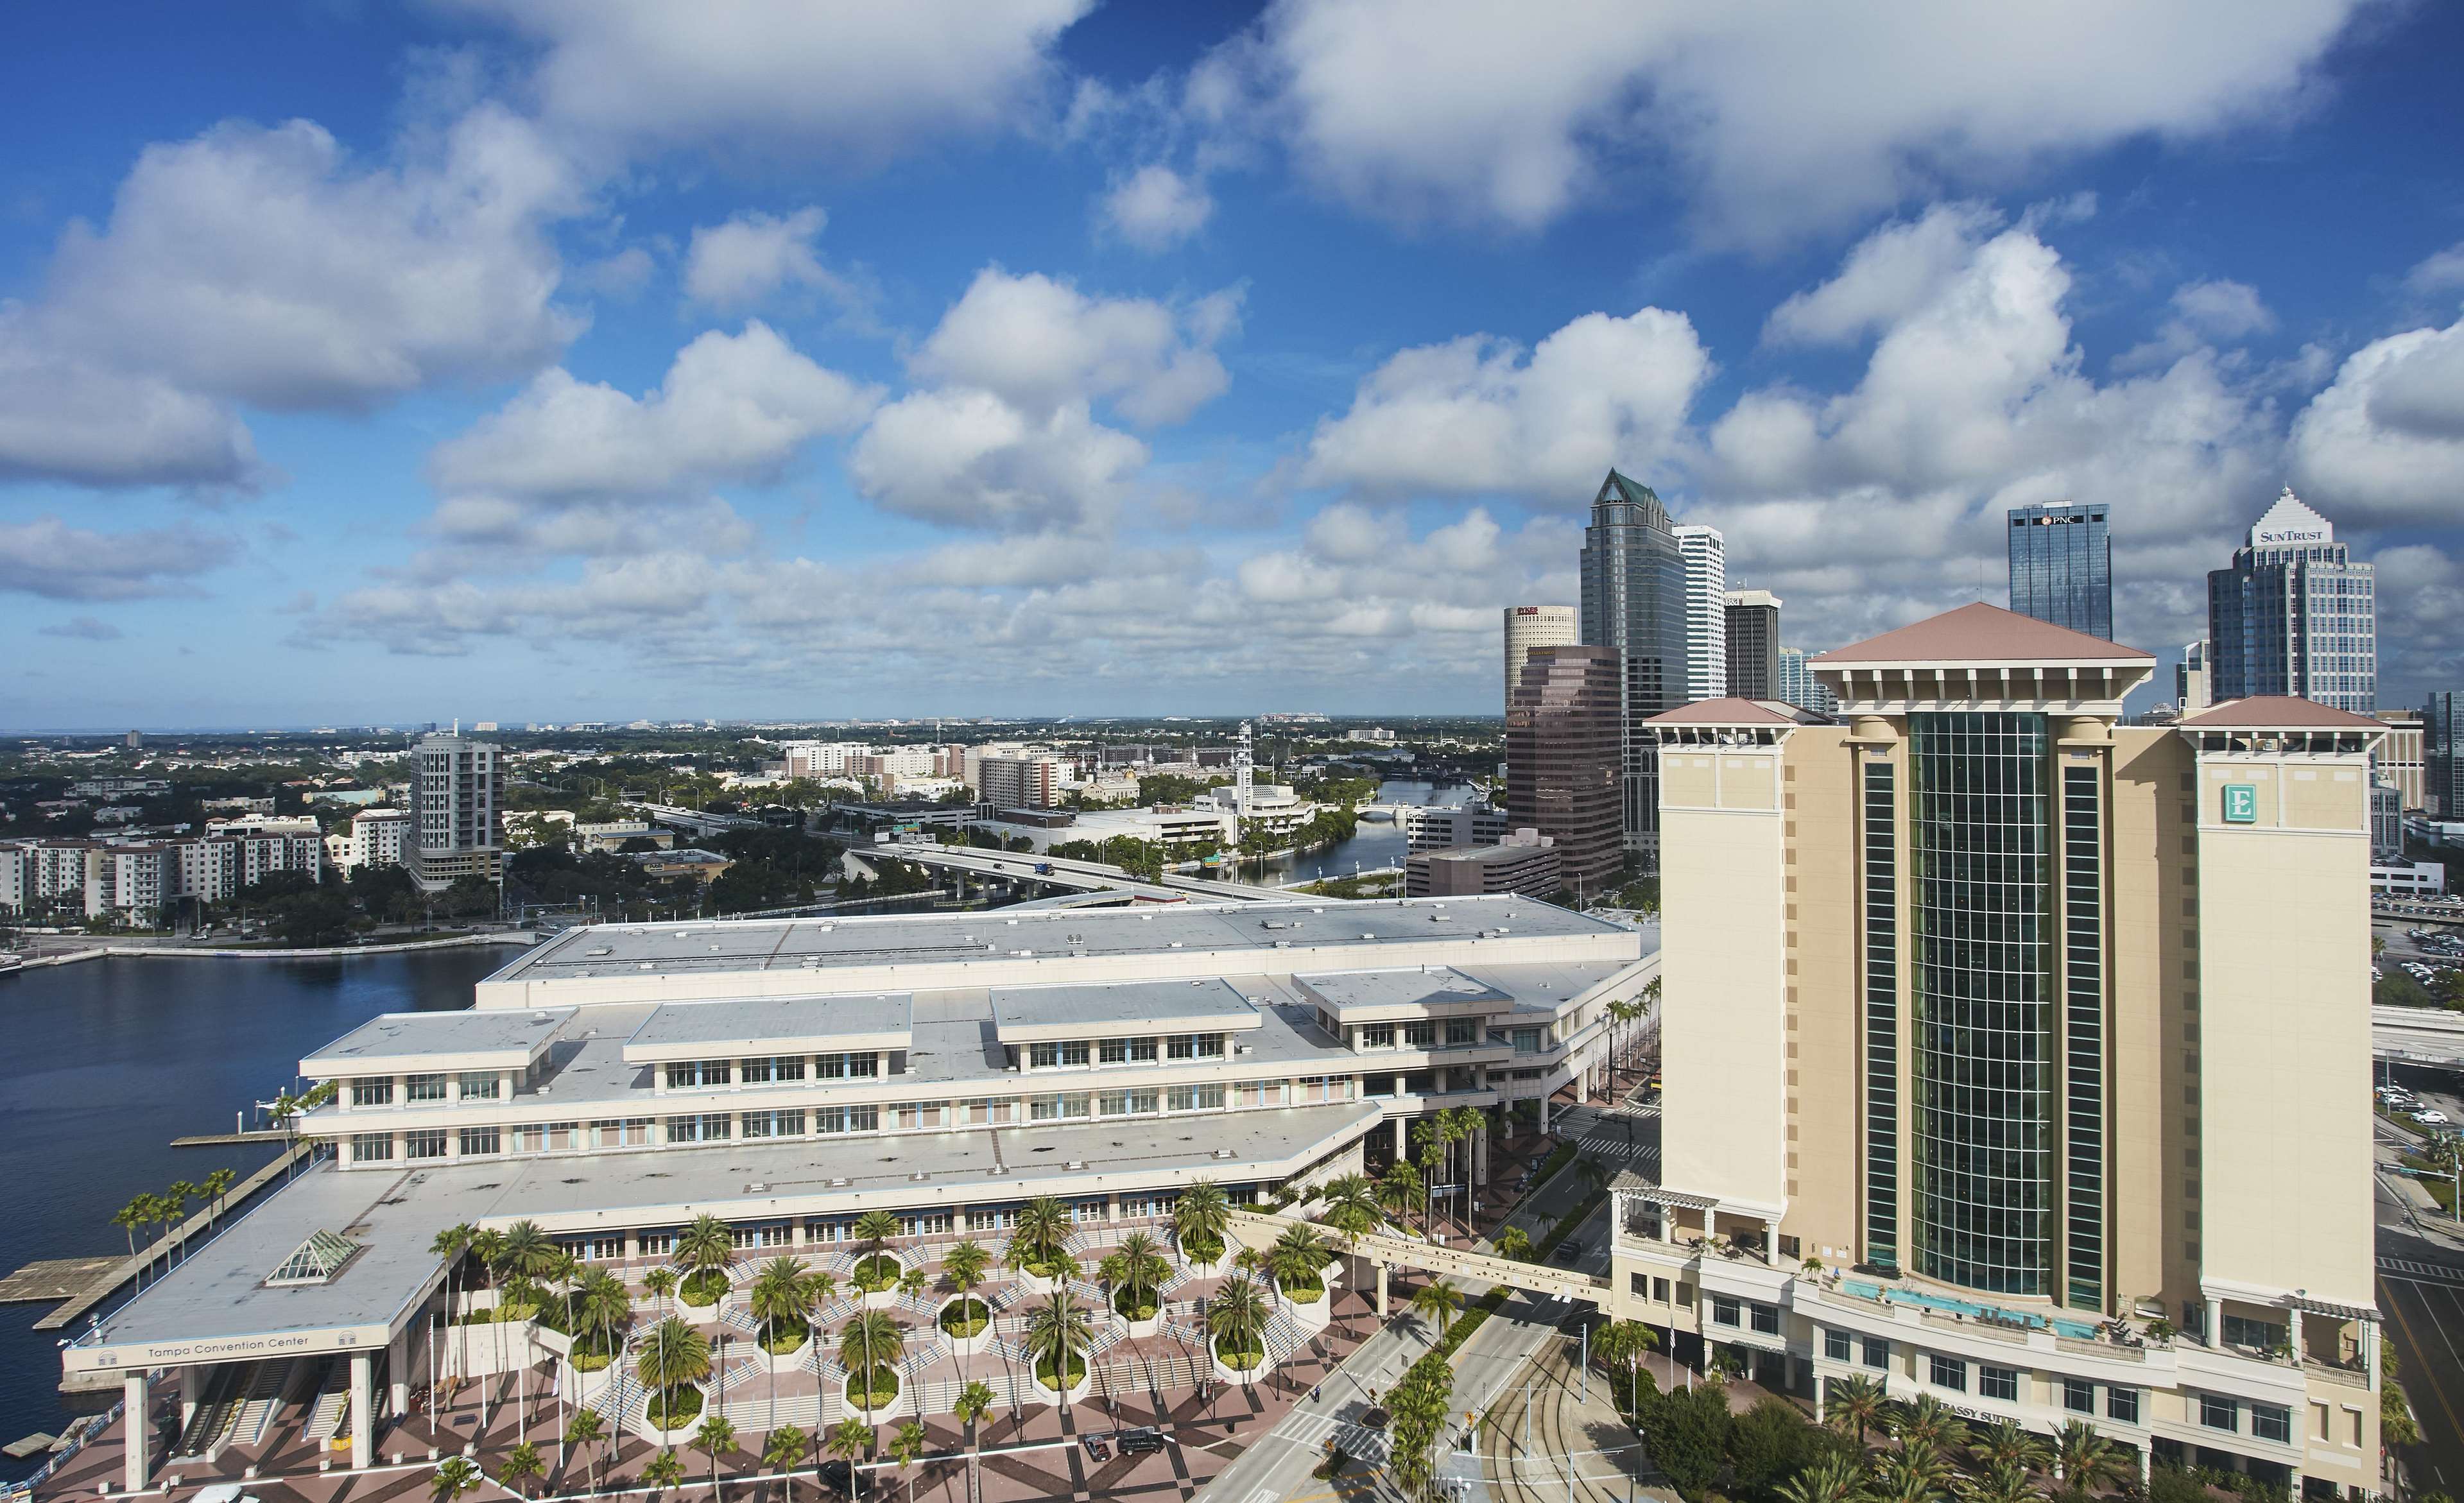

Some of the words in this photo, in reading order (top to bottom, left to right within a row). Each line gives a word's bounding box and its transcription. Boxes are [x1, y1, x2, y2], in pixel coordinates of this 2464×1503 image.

[149, 1347, 190, 1357] Tampa
[194, 1341, 264, 1353] Convention
[268, 1337, 308, 1348] Center
